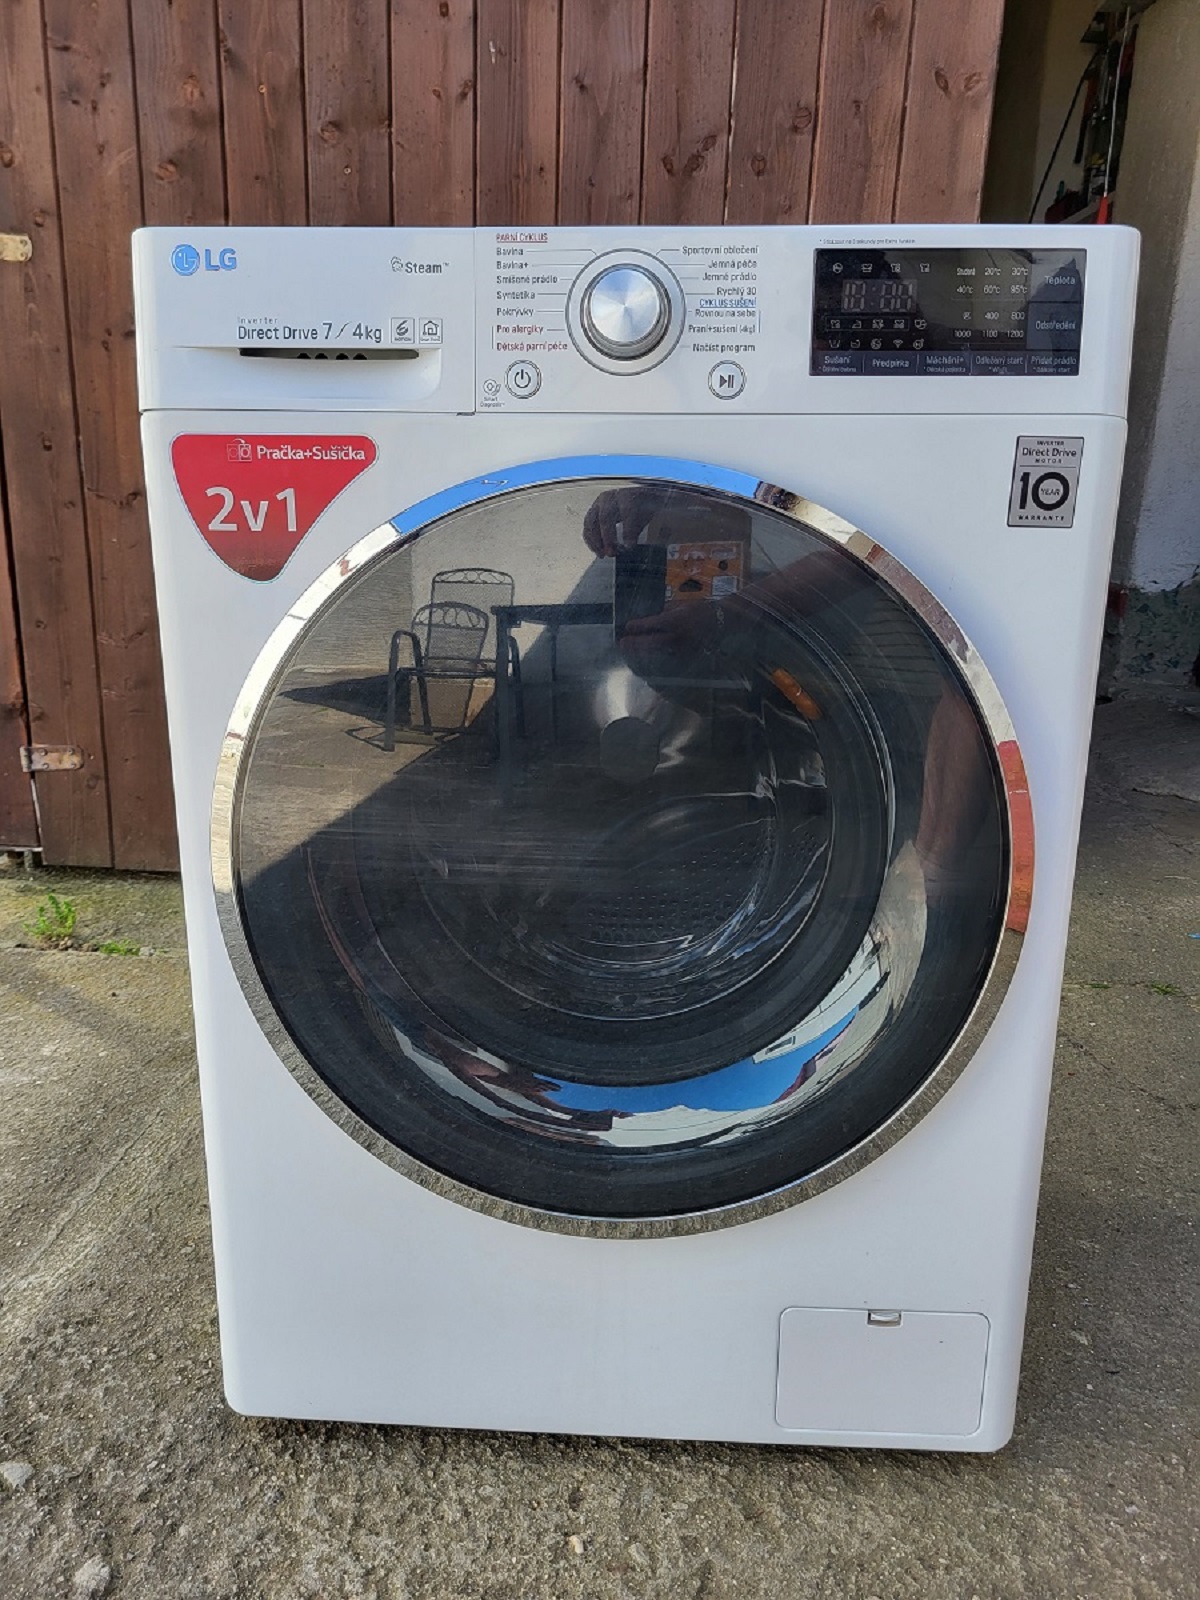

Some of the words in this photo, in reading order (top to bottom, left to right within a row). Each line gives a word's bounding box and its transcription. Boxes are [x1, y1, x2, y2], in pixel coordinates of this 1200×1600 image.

[520, 232, 548, 241] CYKLUS
[496, 247, 524, 256] Bavlna
[682, 245, 722, 256] Sportovní
[205, 248, 237, 271] LG
[708, 260, 736, 268] Jemná
[737, 260, 758, 269] péče
[496, 260, 529, 270] Bavlna+
[532, 275, 558, 285] prádlo
[702, 271, 729, 281] Jemné
[731, 271, 757, 283] prádlo
[1045, 275, 1076, 286] Teplota
[496, 290, 536, 300] Syntetika
[716, 286, 745, 297] Rychlý
[746, 286, 757, 296] 30
[496, 307, 534, 317] Pokrývky
[726, 310, 736, 318] na
[737, 308, 757, 318] sebe
[985, 311, 1000, 320] 400
[237, 316, 278, 325] Inverter
[238, 326, 280, 340] Direct
[283, 326, 319, 340] Drive
[496, 325, 510, 334] Pro
[512, 325, 544, 336] alergiky
[954, 330, 972, 338] 1000
[1007, 330, 1025, 338] 1200
[496, 342, 525, 352] Dětská
[526, 341, 548, 353] parní
[548, 342, 569, 353] péče
[692, 343, 720, 353] Načíst
[720, 345, 757, 355] program
[1007, 356, 1024, 364] start
[257, 444, 365, 461] Pračka+Sušička
[1022, 447, 1050, 457] Direct
[1052, 447, 1077, 457] Drive
[1019, 471, 1070, 512] 10
[1041, 488, 1061, 496] YEAR
